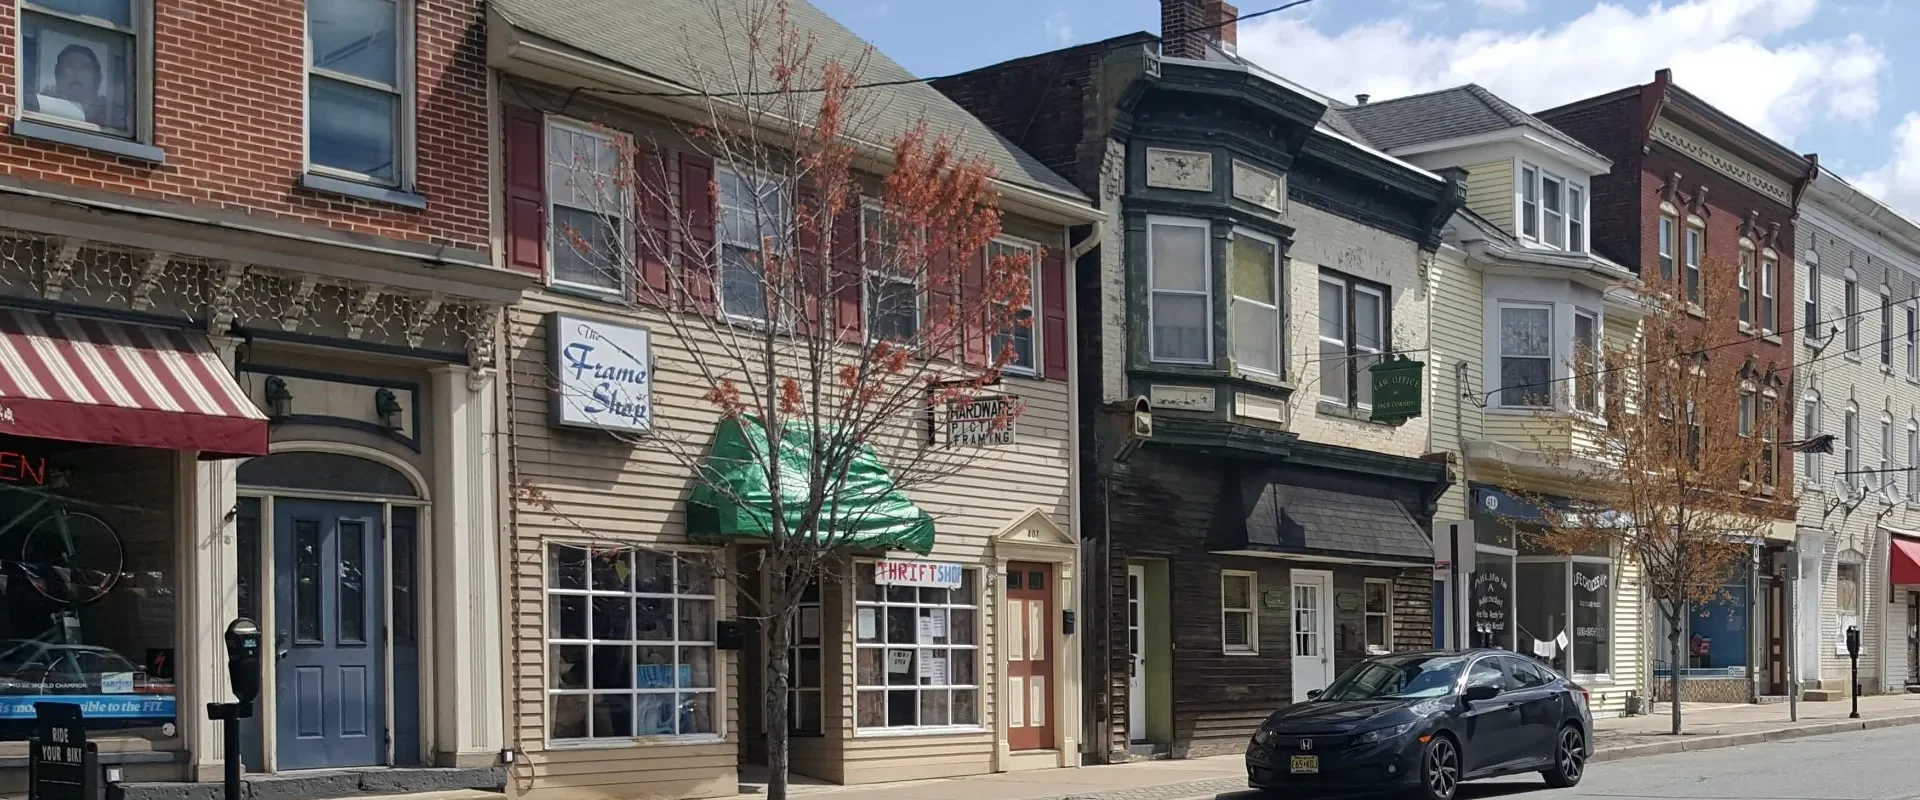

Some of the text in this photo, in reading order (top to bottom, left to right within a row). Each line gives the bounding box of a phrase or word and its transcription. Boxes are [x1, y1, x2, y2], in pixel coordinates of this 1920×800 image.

[577, 324, 600, 341] The
[563, 342, 647, 384] Frame
[1373, 376, 1420, 392] LAW OFFICE
[583, 382, 647, 425] Shop
[950, 400, 1014, 419] HARDWARE
[951, 419, 1013, 435] PICTE
[953, 432, 1010, 446] FRAMING
[877, 561, 962, 583] THRIFT SHOP
[12, 703, 37, 713] mos
[107, 702, 119, 712] to
[121, 700, 141, 712] the
[52, 727, 69, 743] RIDE
[42, 744, 61, 761] YOUR
